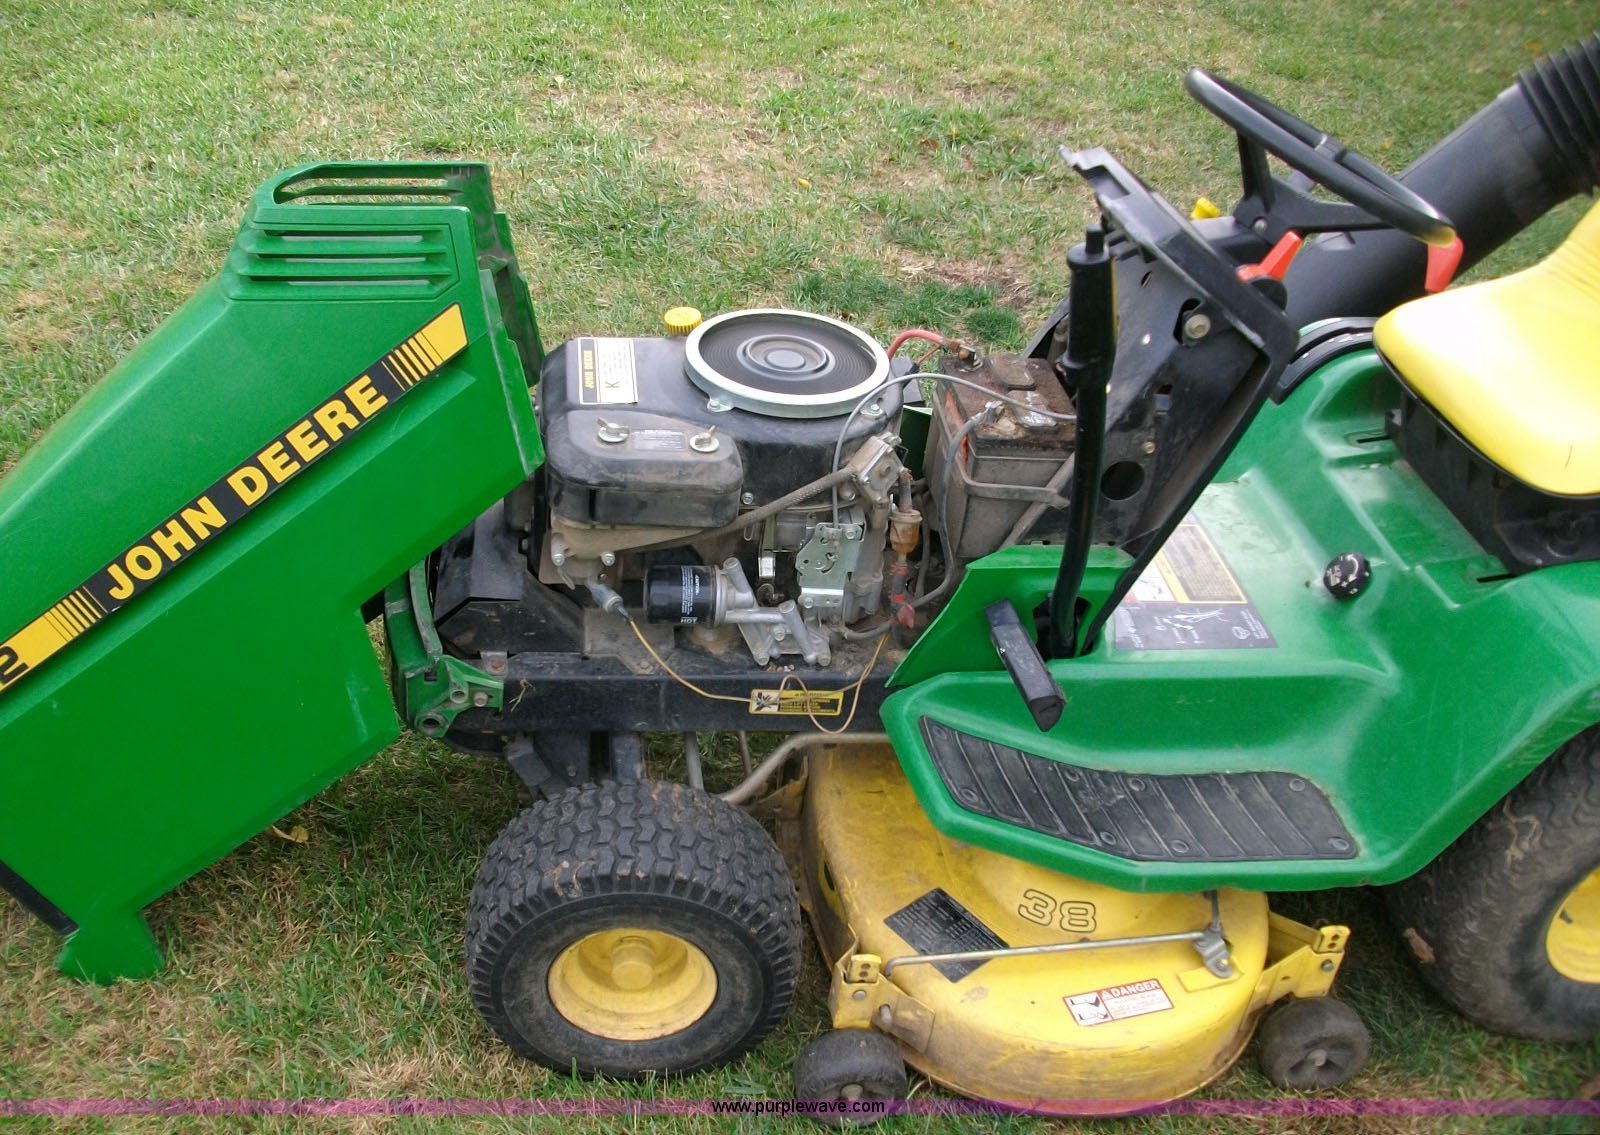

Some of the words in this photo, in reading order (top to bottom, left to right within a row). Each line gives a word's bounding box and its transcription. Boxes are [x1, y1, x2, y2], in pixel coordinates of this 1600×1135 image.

[107, 496, 227, 600] JOHN
[227, 375, 389, 506] DEERE
[1018, 889, 1097, 933] 38
[1110, 980, 1160, 998] DANGER
